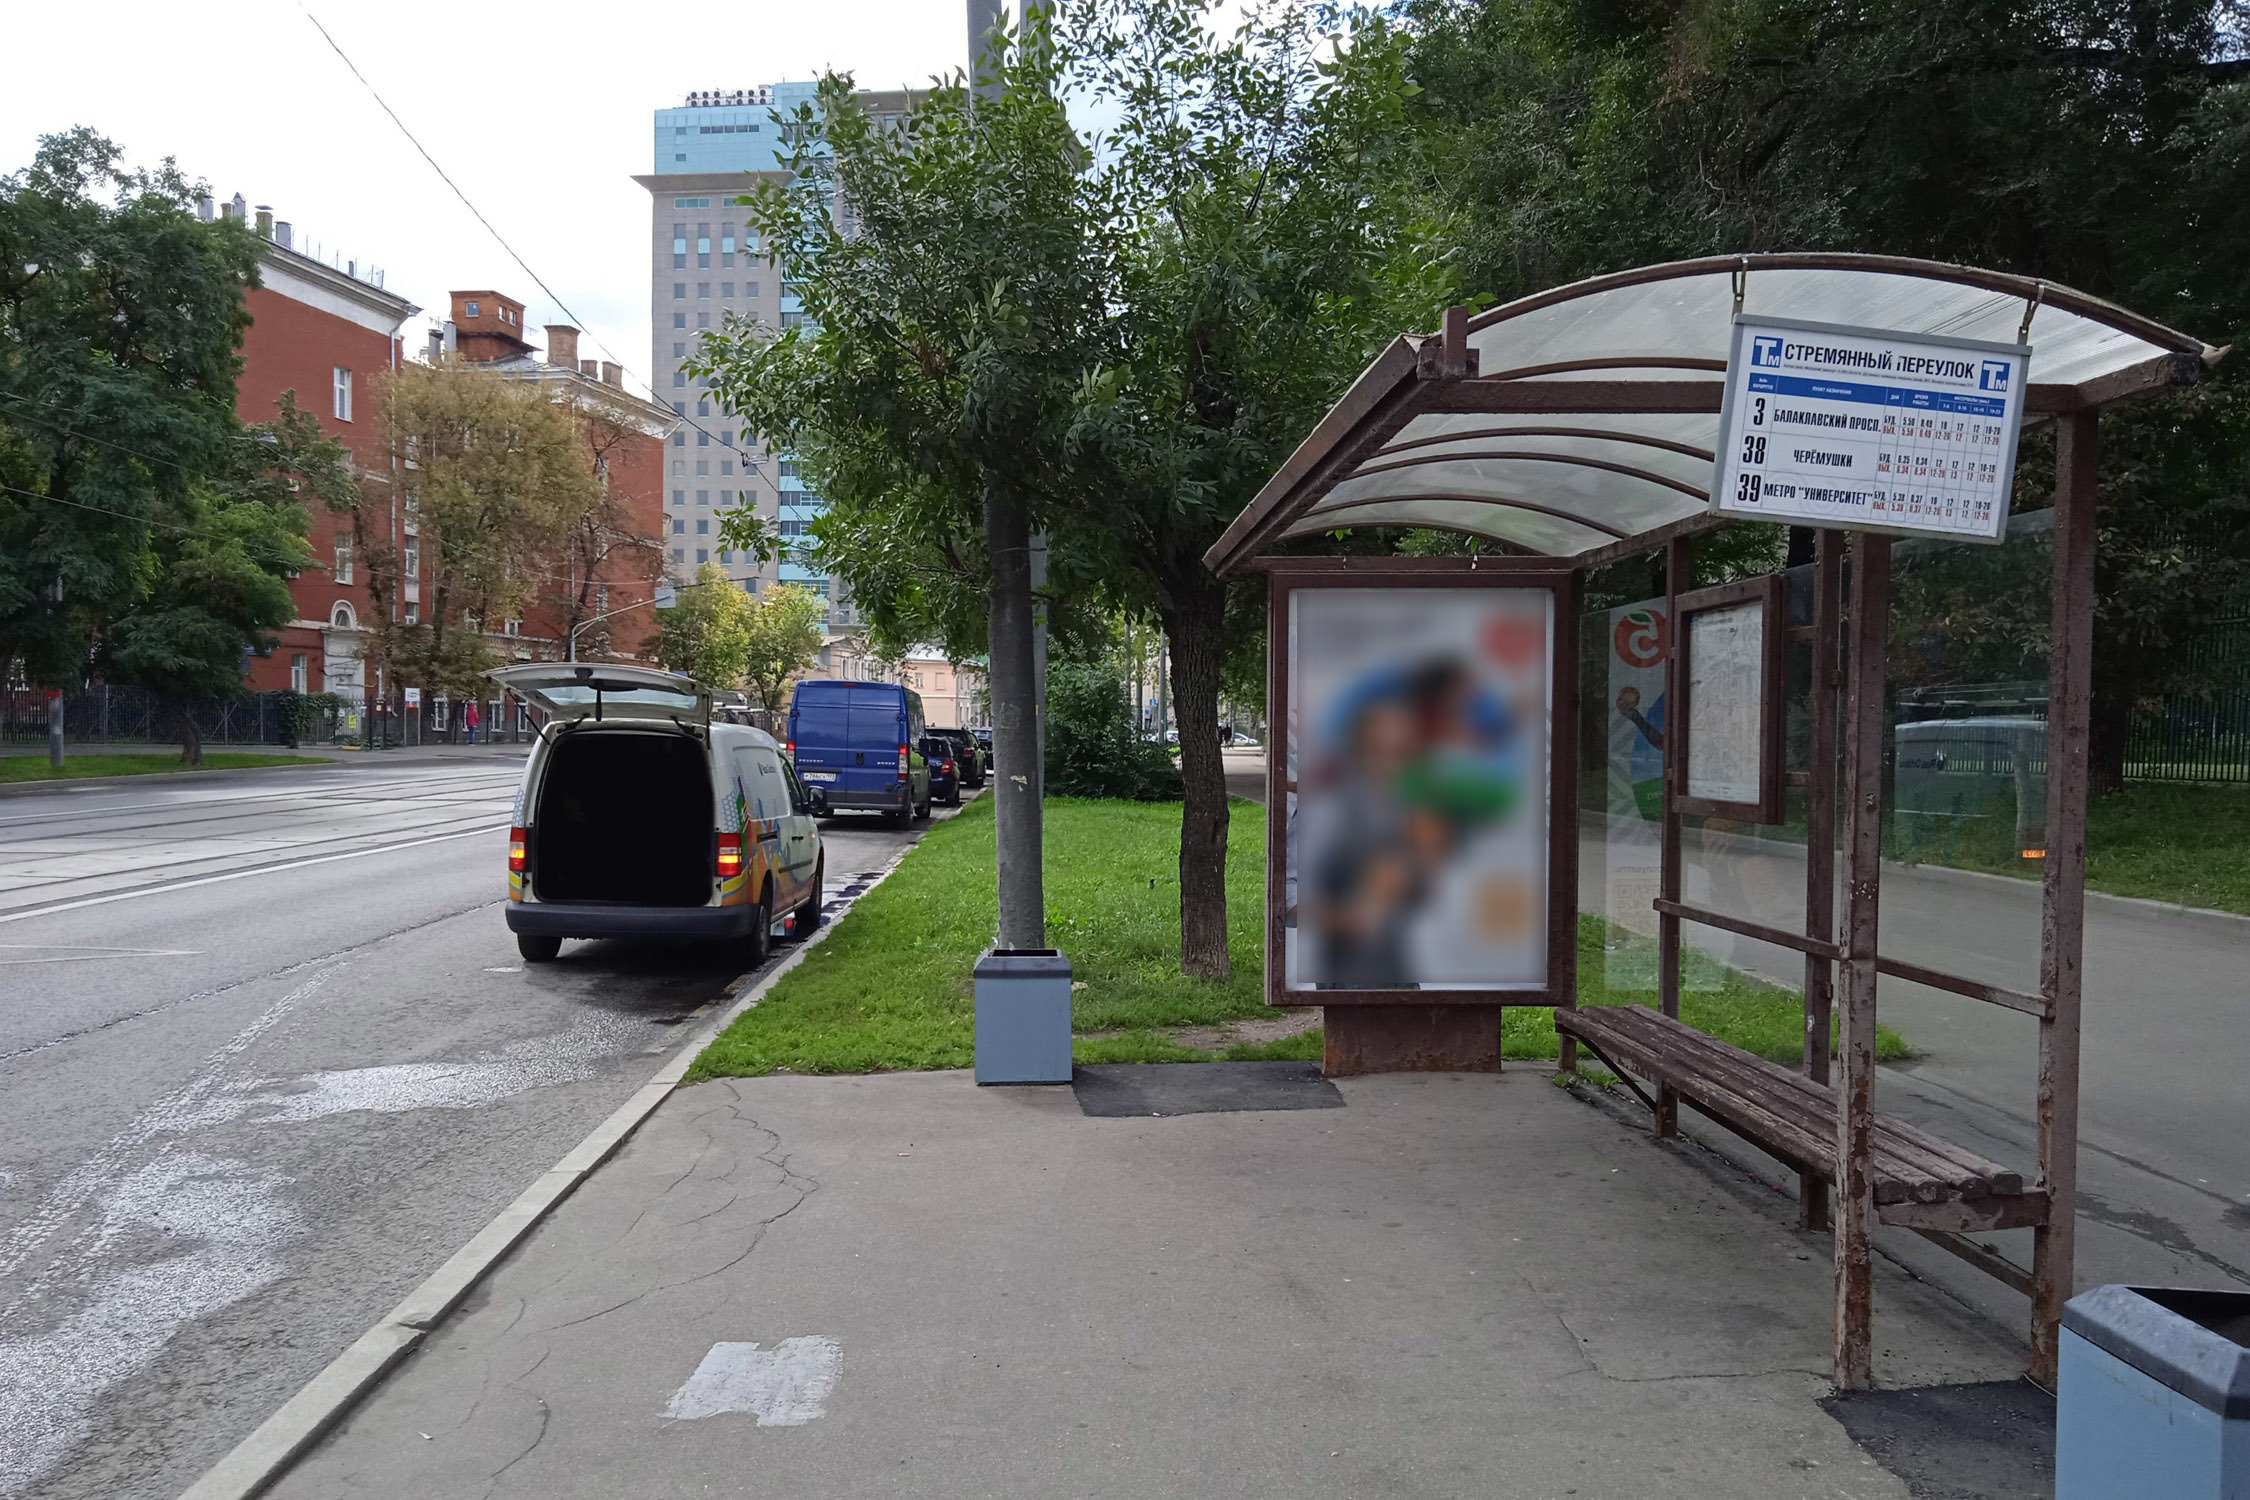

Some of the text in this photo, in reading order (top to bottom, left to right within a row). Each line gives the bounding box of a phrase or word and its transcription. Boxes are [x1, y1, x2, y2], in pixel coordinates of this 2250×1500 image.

[1785, 343, 1893, 371] СТРЕМЯННЫЙ
[1896, 355, 1975, 379] ПЕРЕУЛОК
[1753, 397, 1766, 426] 3
[1773, 408, 1882, 432] БАЛАКЛАВСКИЙ ПРОСП.
[1957, 423, 1964, 431] 12
[1973, 425, 1980, 433] 12
[1742, 435, 1766, 464] 38
[1793, 449, 1853, 468] ЧЕРЁМУШКИ
[1952, 460, 1959, 469] 12
[1968, 462, 1975, 471] 12
[1737, 474, 1761, 502] 39
[1763, 483, 1796, 499] МЕТРО
[1946, 498, 1954, 507] 12
[1963, 500, 1970, 508] 12
